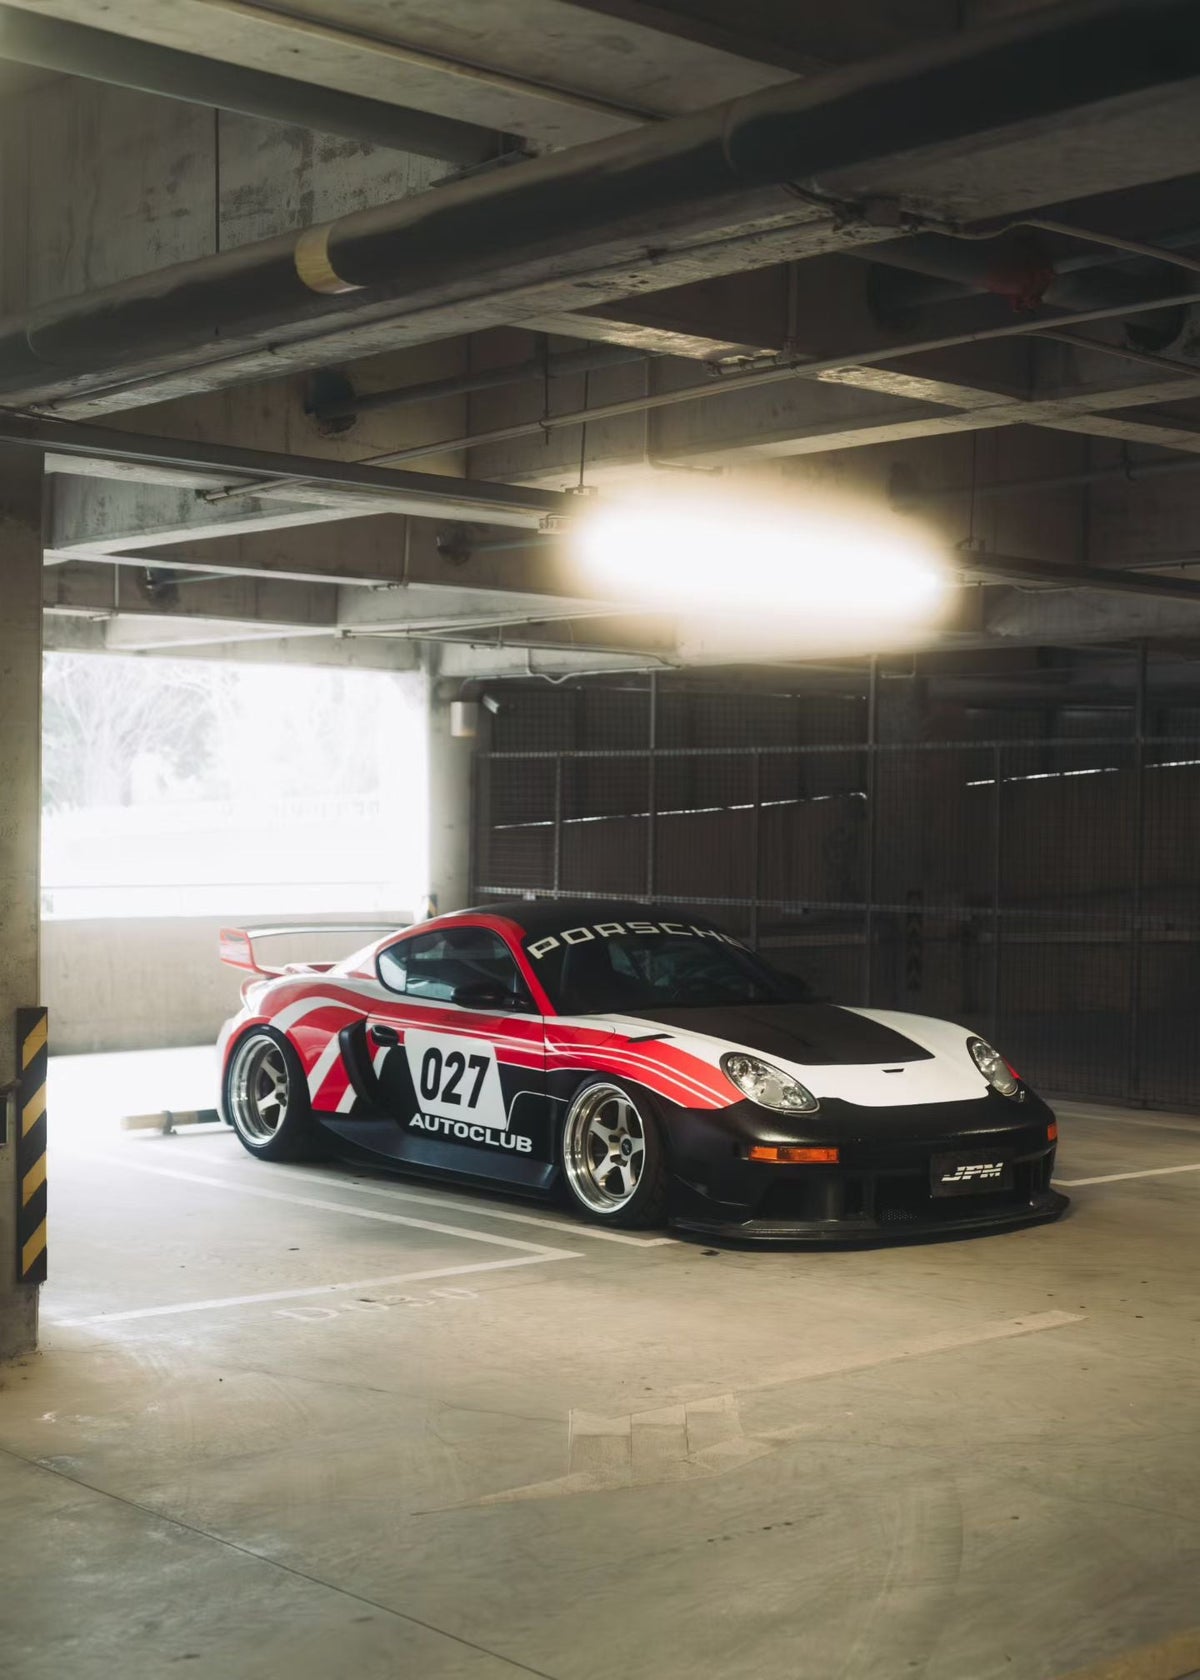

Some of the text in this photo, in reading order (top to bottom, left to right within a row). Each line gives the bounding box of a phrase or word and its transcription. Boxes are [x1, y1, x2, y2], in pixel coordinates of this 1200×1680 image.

[420, 1047, 490, 1109] 027
[409, 1112, 533, 1153] AUTOCLUB
[941, 1162, 1004, 1182] JPM
